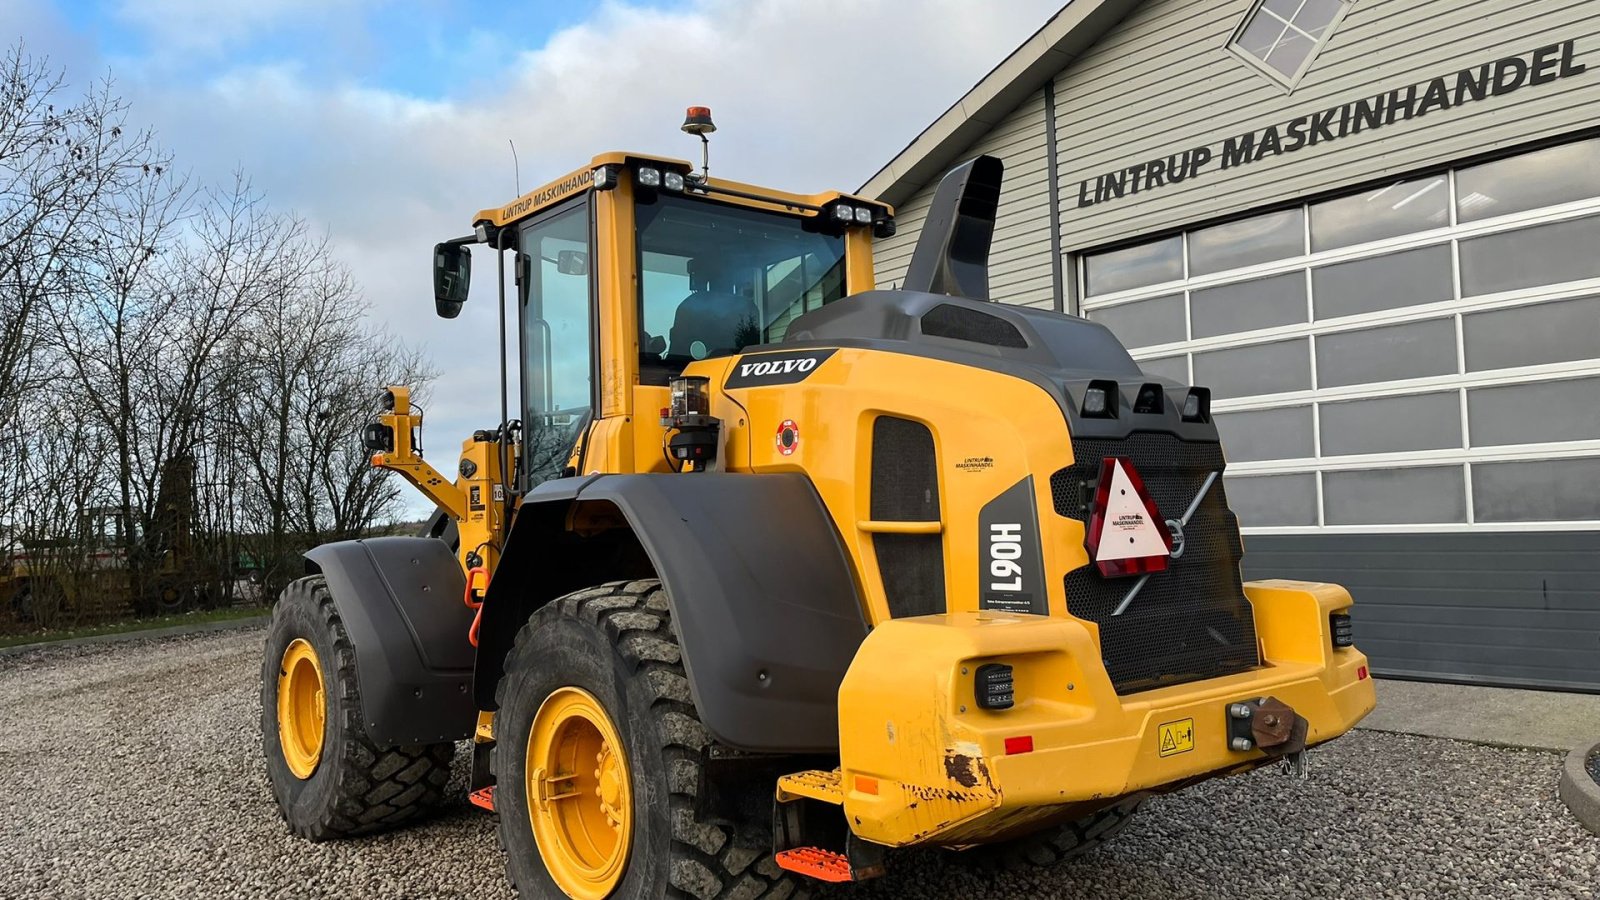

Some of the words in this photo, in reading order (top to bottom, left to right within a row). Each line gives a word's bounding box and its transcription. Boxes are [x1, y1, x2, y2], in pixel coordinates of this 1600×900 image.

[1078, 145, 1211, 208] LINTRUP
[1220, 39, 1586, 170] MASKINHANDEL
[502, 198, 532, 220] LINTRUP
[741, 357, 817, 377] VOLVO
[990, 523, 1022, 591] L90H
